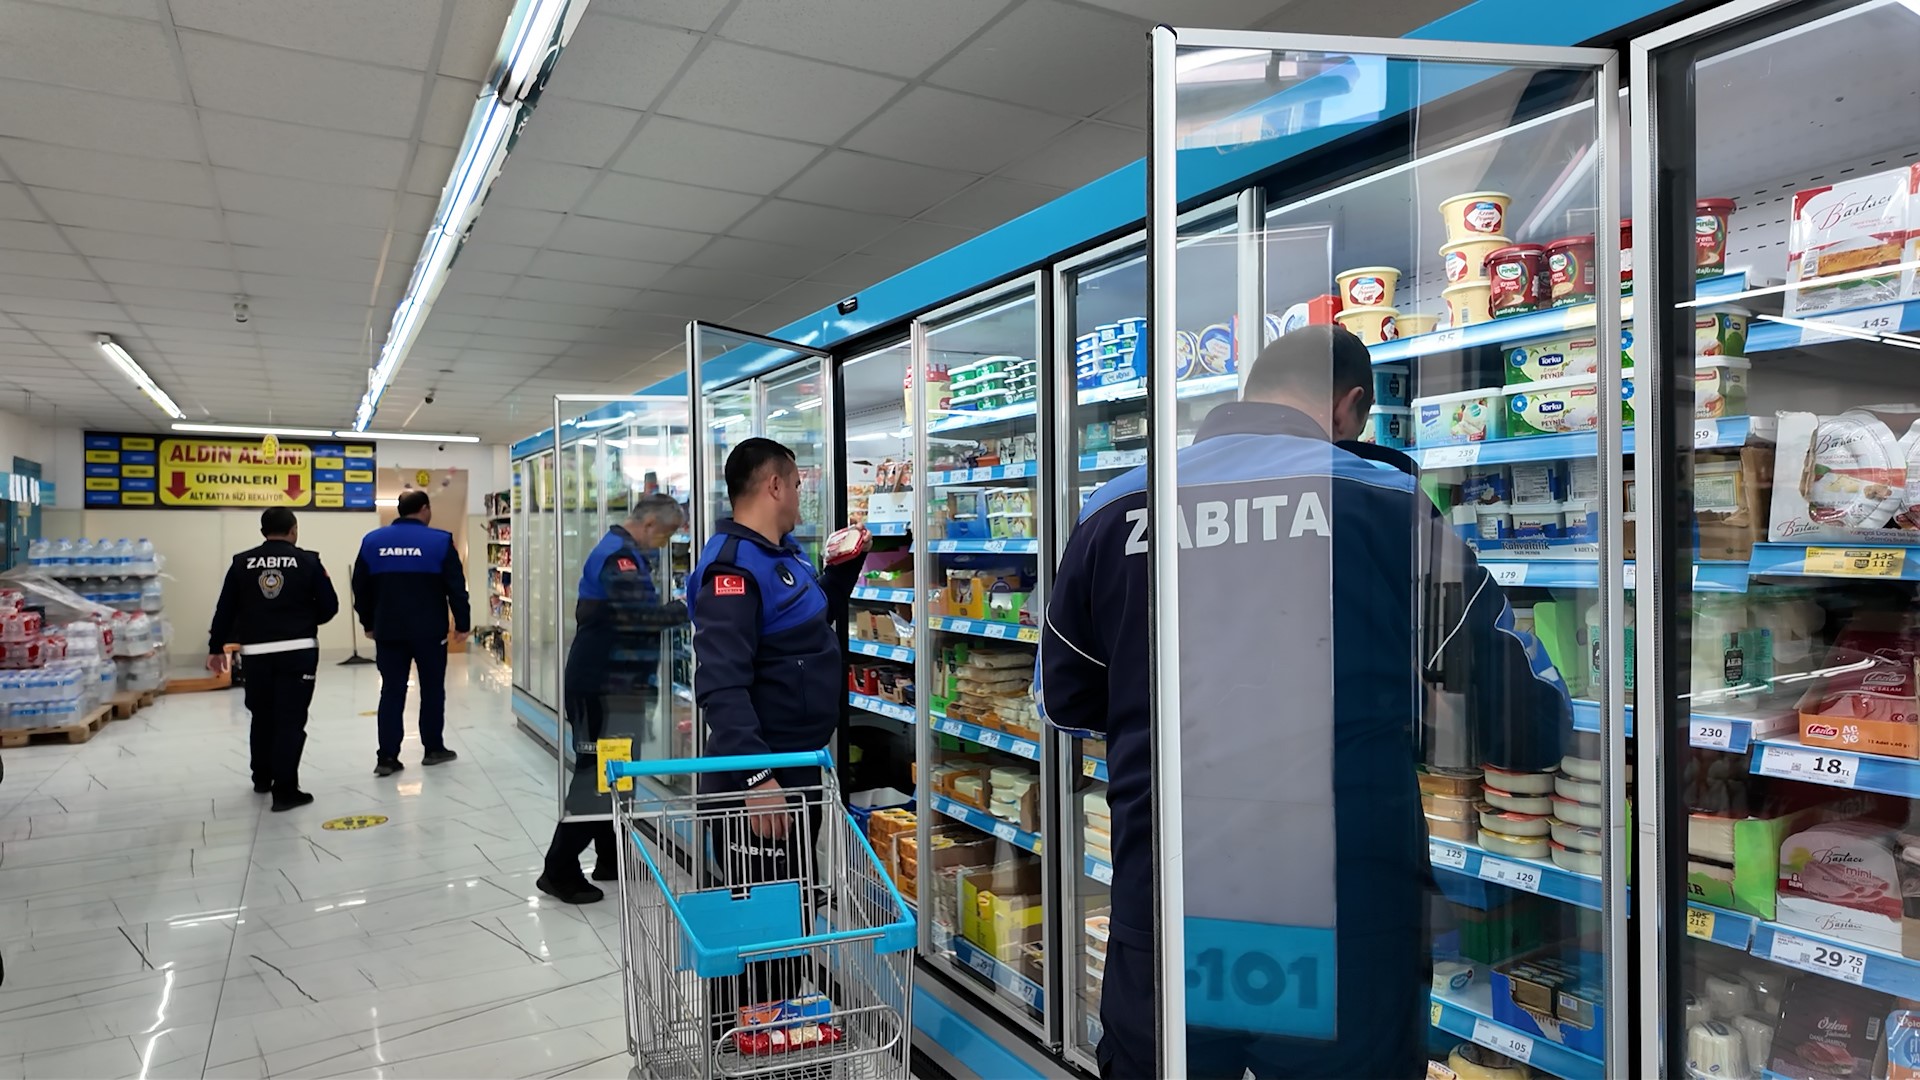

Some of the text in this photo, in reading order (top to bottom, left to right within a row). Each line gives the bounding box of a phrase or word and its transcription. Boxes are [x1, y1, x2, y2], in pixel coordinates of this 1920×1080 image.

[1862, 317, 1890, 329] 145
[1541, 355, 1562, 364] Torku
[1541, 402, 1562, 411] Torku
[1457, 449, 1475, 458] 239
[195, 473, 277, 485] ÜRÜNLERİ
[190, 491, 204, 501] ALT
[206, 492, 230, 501] KATTA
[1502, 540, 1551, 551] Kahvaltılık
[379, 547, 422, 557] ZABITA
[246, 556, 298, 569] ZABITA
[1872, 560, 1894, 568] 115
[1500, 571, 1517, 579] 179
[1700, 727, 1723, 738] 230
[1813, 756, 1851, 777] 18 TL
[1446, 849, 1462, 859] 125
[1516, 872, 1534, 883] 129
[1845, 867, 1872, 879] mini
[1689, 918, 1706, 927] 215
[1850, 965, 1862, 975] TL
[1817, 1016, 1848, 1032] Özlem
[1509, 1040, 1527, 1053] 105
